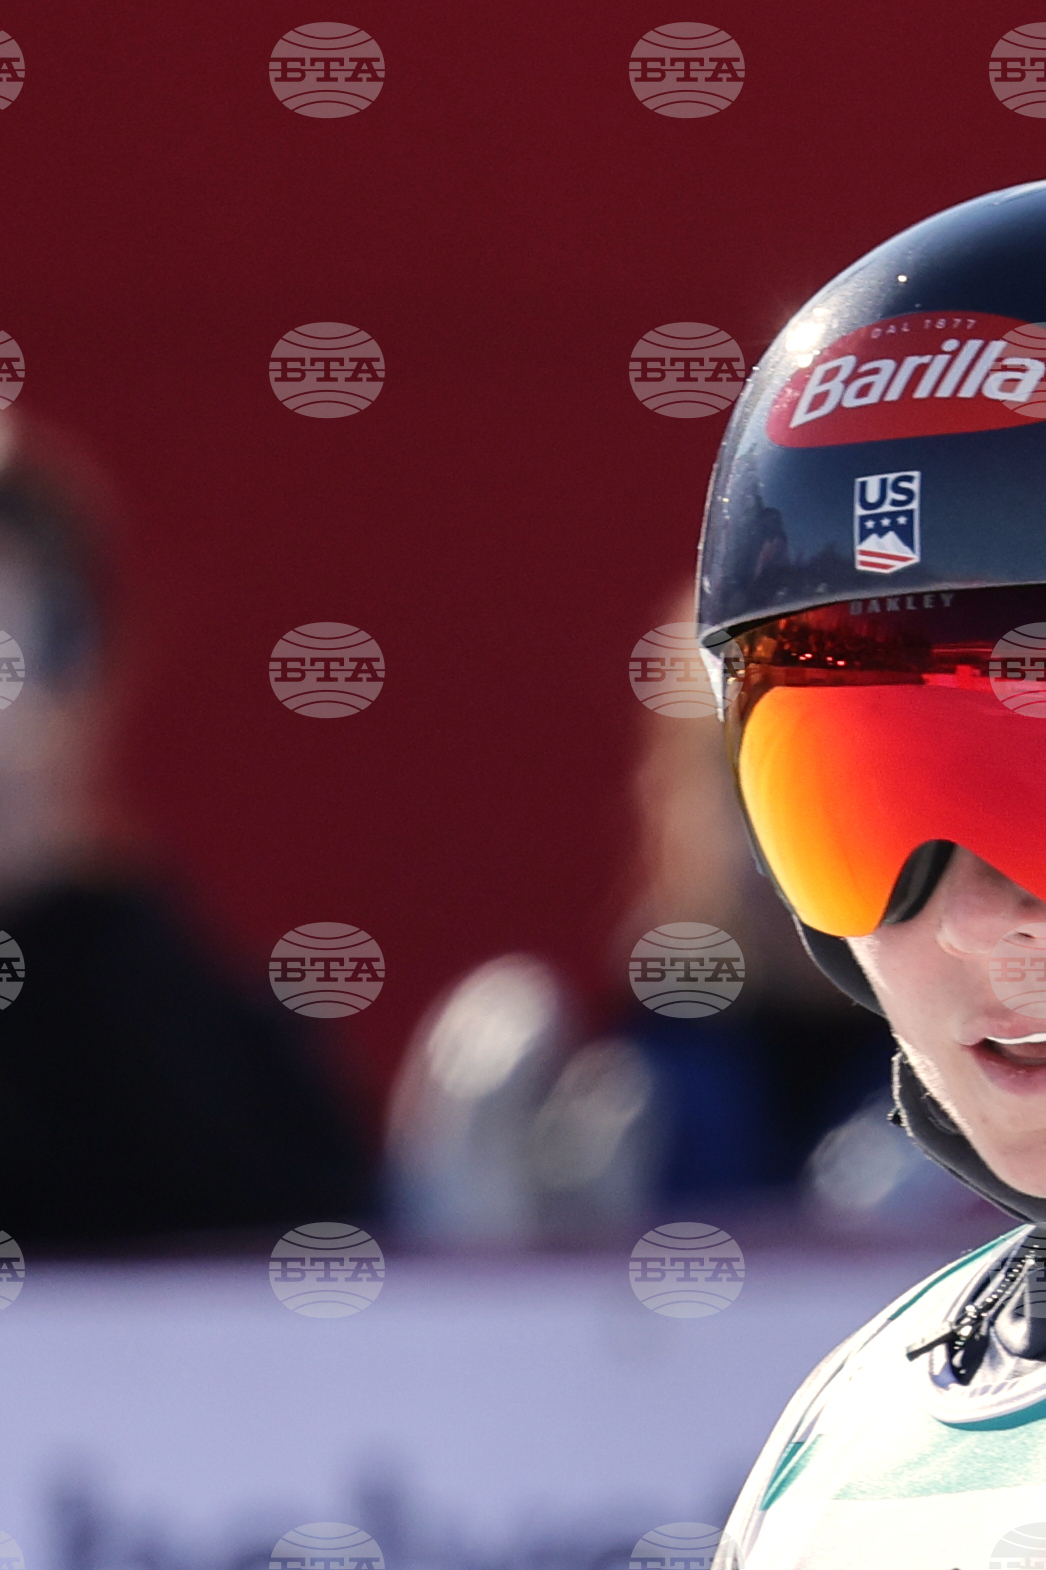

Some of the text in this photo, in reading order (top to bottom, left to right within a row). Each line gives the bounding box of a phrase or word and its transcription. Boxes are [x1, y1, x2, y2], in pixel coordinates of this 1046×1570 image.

[923, 317, 978, 330] 1877
[789, 338, 1046, 429] Barilla
[859, 474, 916, 511] US
[850, 593, 957, 616] OAKLEY
